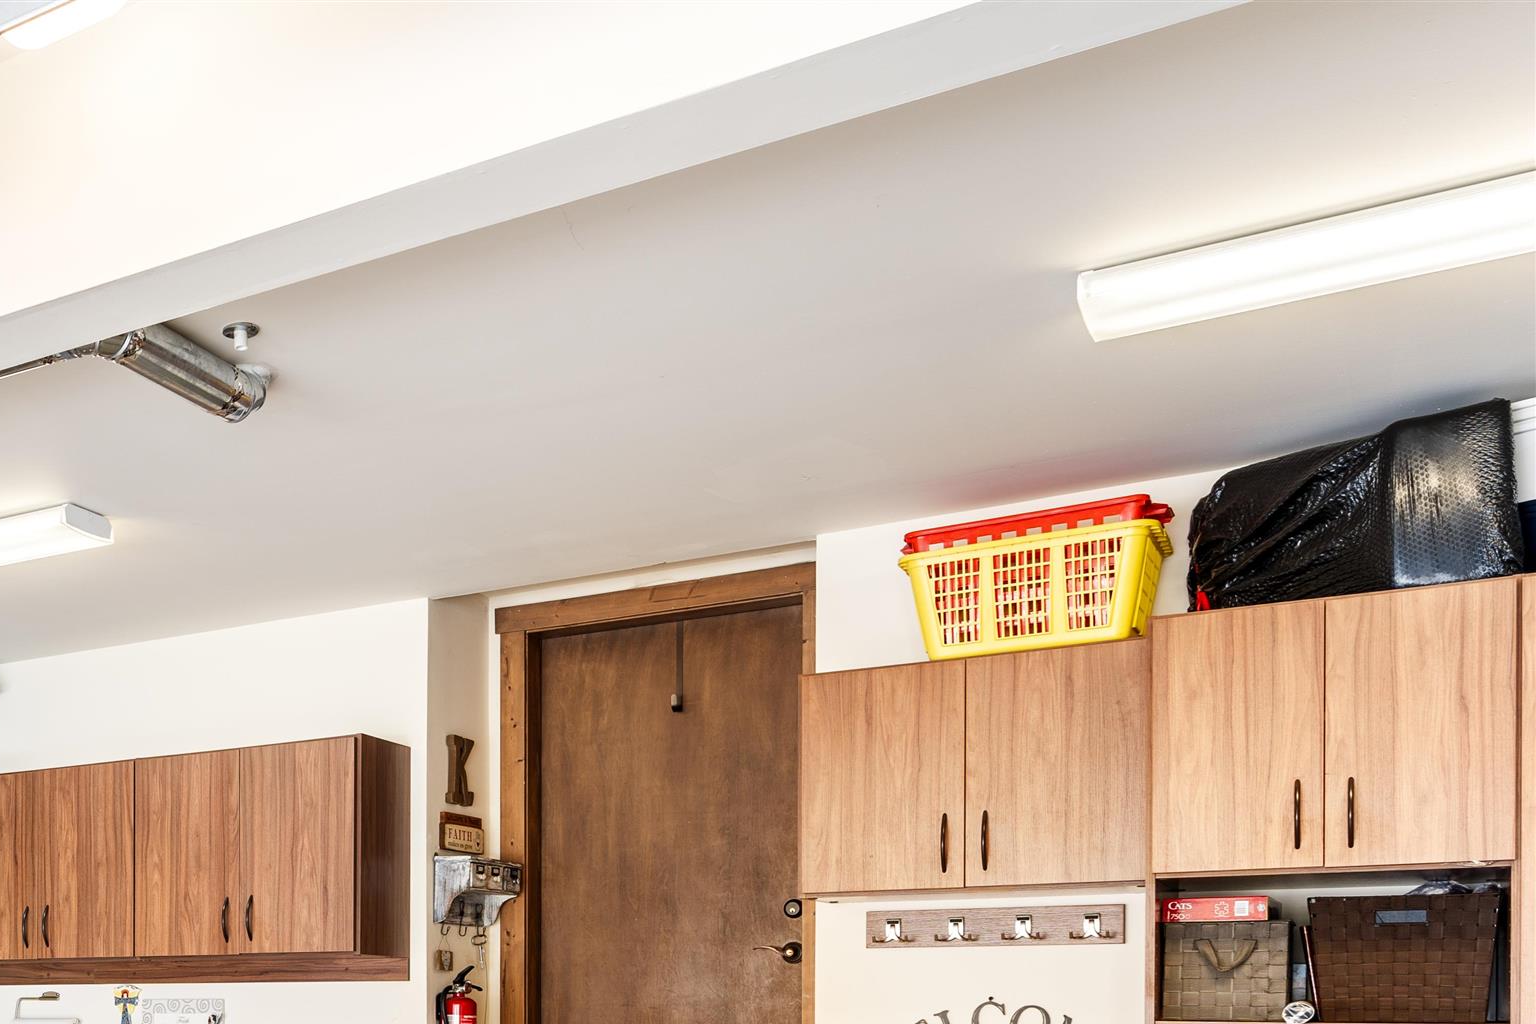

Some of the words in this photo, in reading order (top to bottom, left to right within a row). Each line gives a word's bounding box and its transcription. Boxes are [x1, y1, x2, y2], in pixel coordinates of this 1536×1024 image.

[444, 734, 475, 807] K
[447, 827, 473, 843] FAITH
[1167, 901, 1193, 911] CATS
[1170, 913, 1186, 921] 750
